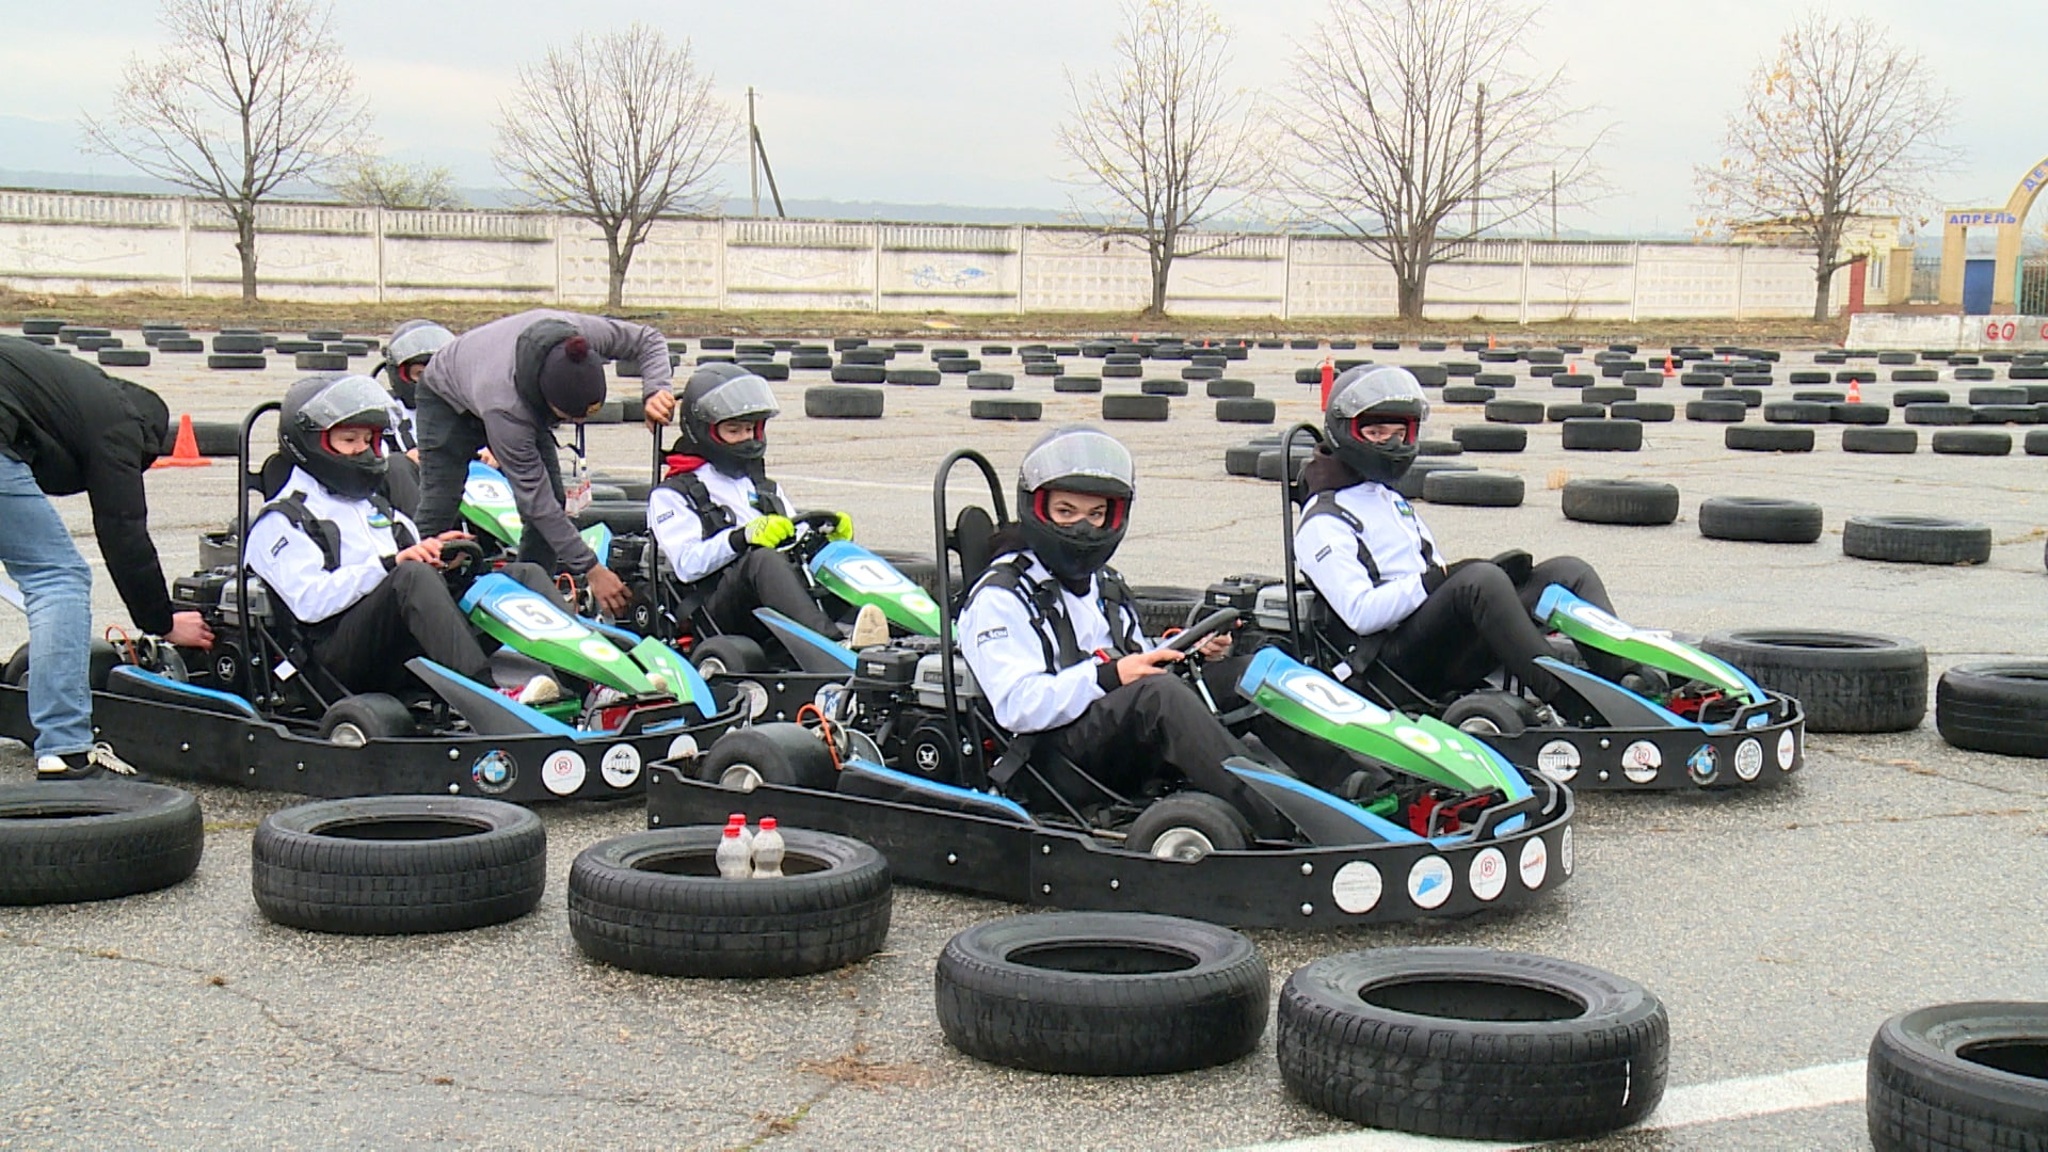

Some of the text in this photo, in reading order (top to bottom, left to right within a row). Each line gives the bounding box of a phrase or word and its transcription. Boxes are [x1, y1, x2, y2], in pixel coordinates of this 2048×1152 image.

[1949, 212, 2016, 224] АПРЕЛЬ
[1986, 322, 2015, 341] GO
[516, 603, 554, 625] 5
[1305, 681, 1350, 706] 2
